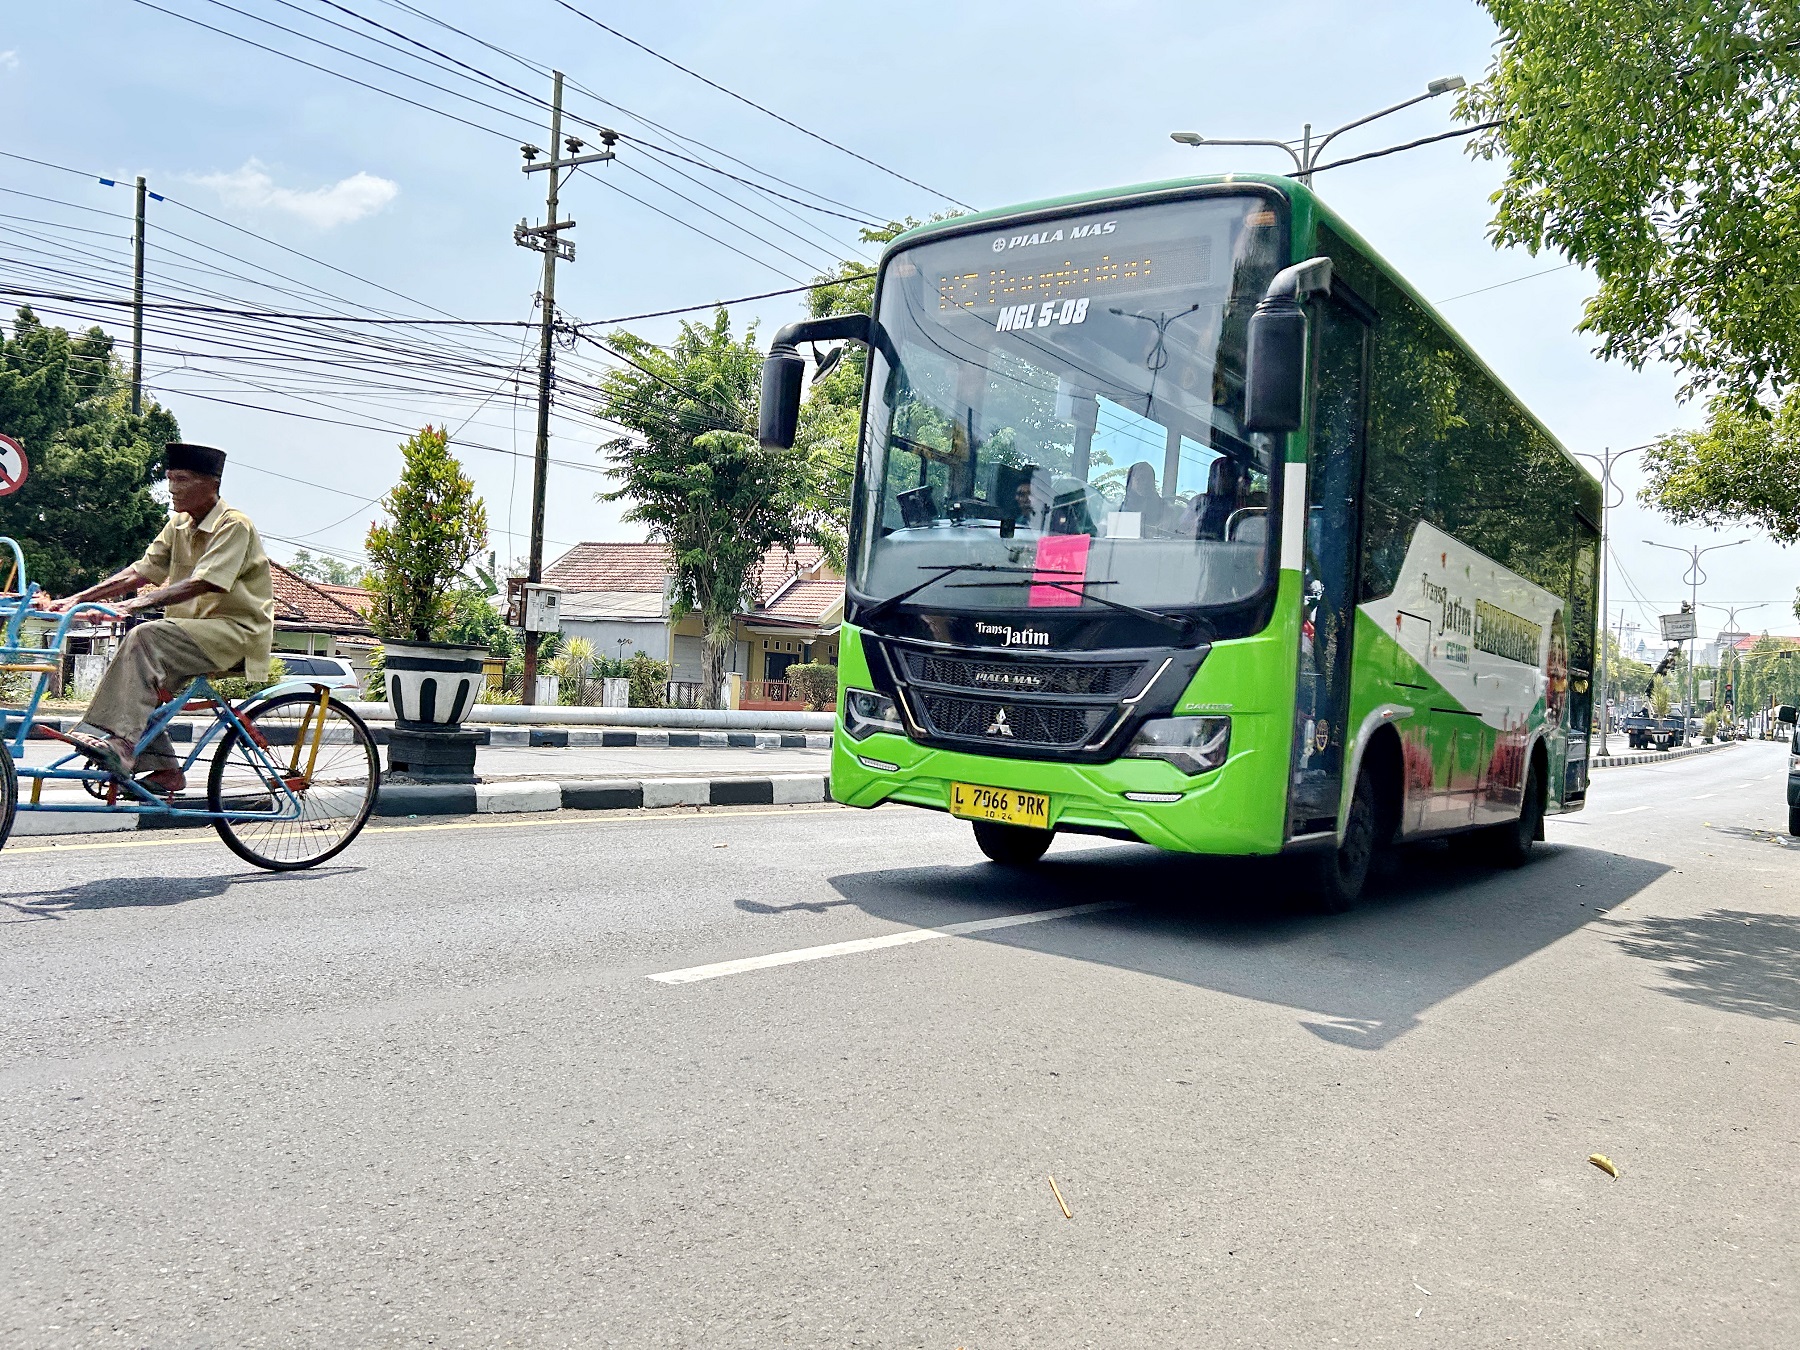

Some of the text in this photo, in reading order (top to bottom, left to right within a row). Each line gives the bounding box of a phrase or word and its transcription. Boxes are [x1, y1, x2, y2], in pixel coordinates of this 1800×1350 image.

[1008, 220, 1118, 249] PIALA MAS
[996, 297, 1090, 332] MGL 5-08
[1438, 586, 1471, 637] Jatim
[975, 621, 1003, 635] Trans
[1001, 626, 1050, 647] Jatim
[1012, 675, 1041, 685] MAS
[955, 786, 1045, 816] L 7066 PRK
